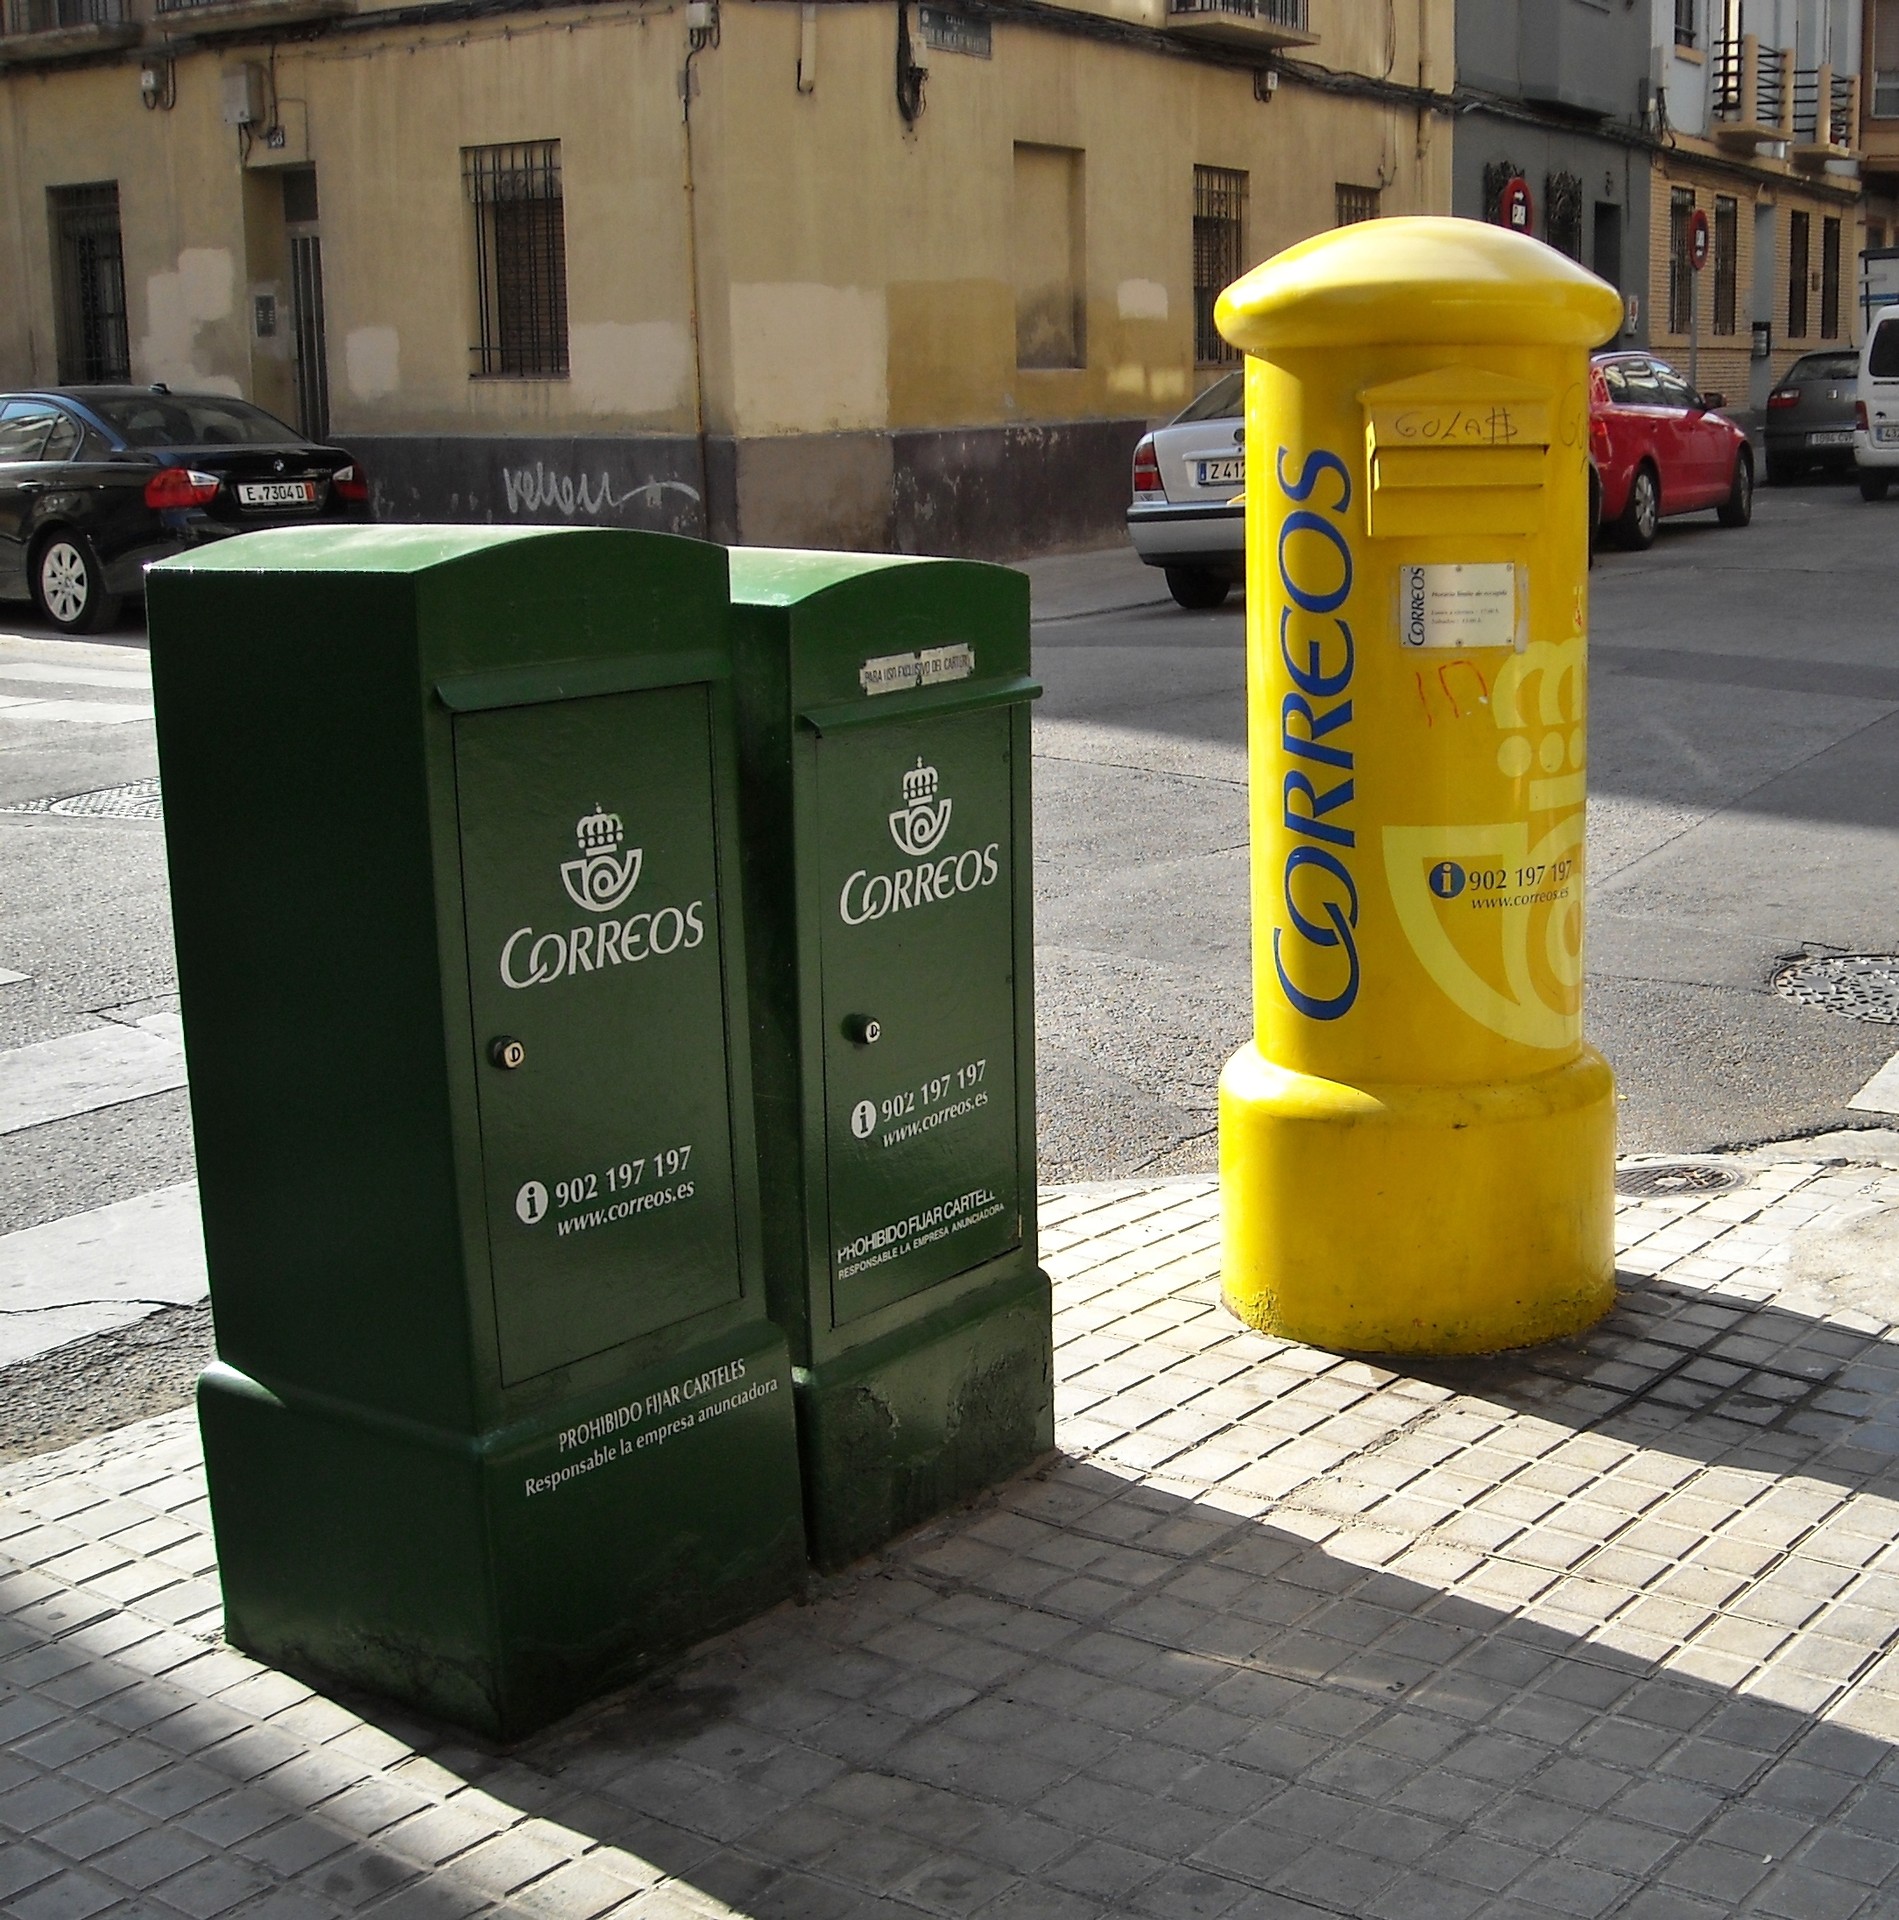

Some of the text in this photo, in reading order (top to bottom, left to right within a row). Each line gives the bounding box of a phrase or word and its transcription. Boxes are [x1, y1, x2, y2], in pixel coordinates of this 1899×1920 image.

[246, 484, 305, 501] E 7304 D
[1211, 463, 1220, 479] Z
[1408, 566, 1425, 646] CORREOS
[1274, 446, 1359, 1022] CORREOS
[840, 842, 999, 925] CORREOS
[1469, 860, 1572, 891] 902 197 197
[1471, 887, 1569, 909] www.correos.es
[500, 900, 705, 989] CORREOS
[881, 1059, 986, 1122] 902 197 197
[883, 1090, 989, 1148] www.correos.es
[555, 1145, 692, 1208] 902 197 197
[558, 1180, 695, 1236] www.correos.es
[837, 1221, 908, 1264] PROHIBIDO
[908, 1205, 943, 1235] FIJAR
[838, 1202, 1005, 1280] RESPONSABLE LA EMPRESA ANUNCIADORA
[558, 1357, 747, 1453] PROHIBIDO FIJAR CARTELES
[525, 1378, 778, 1497] Responsable la empresa anunciadora
